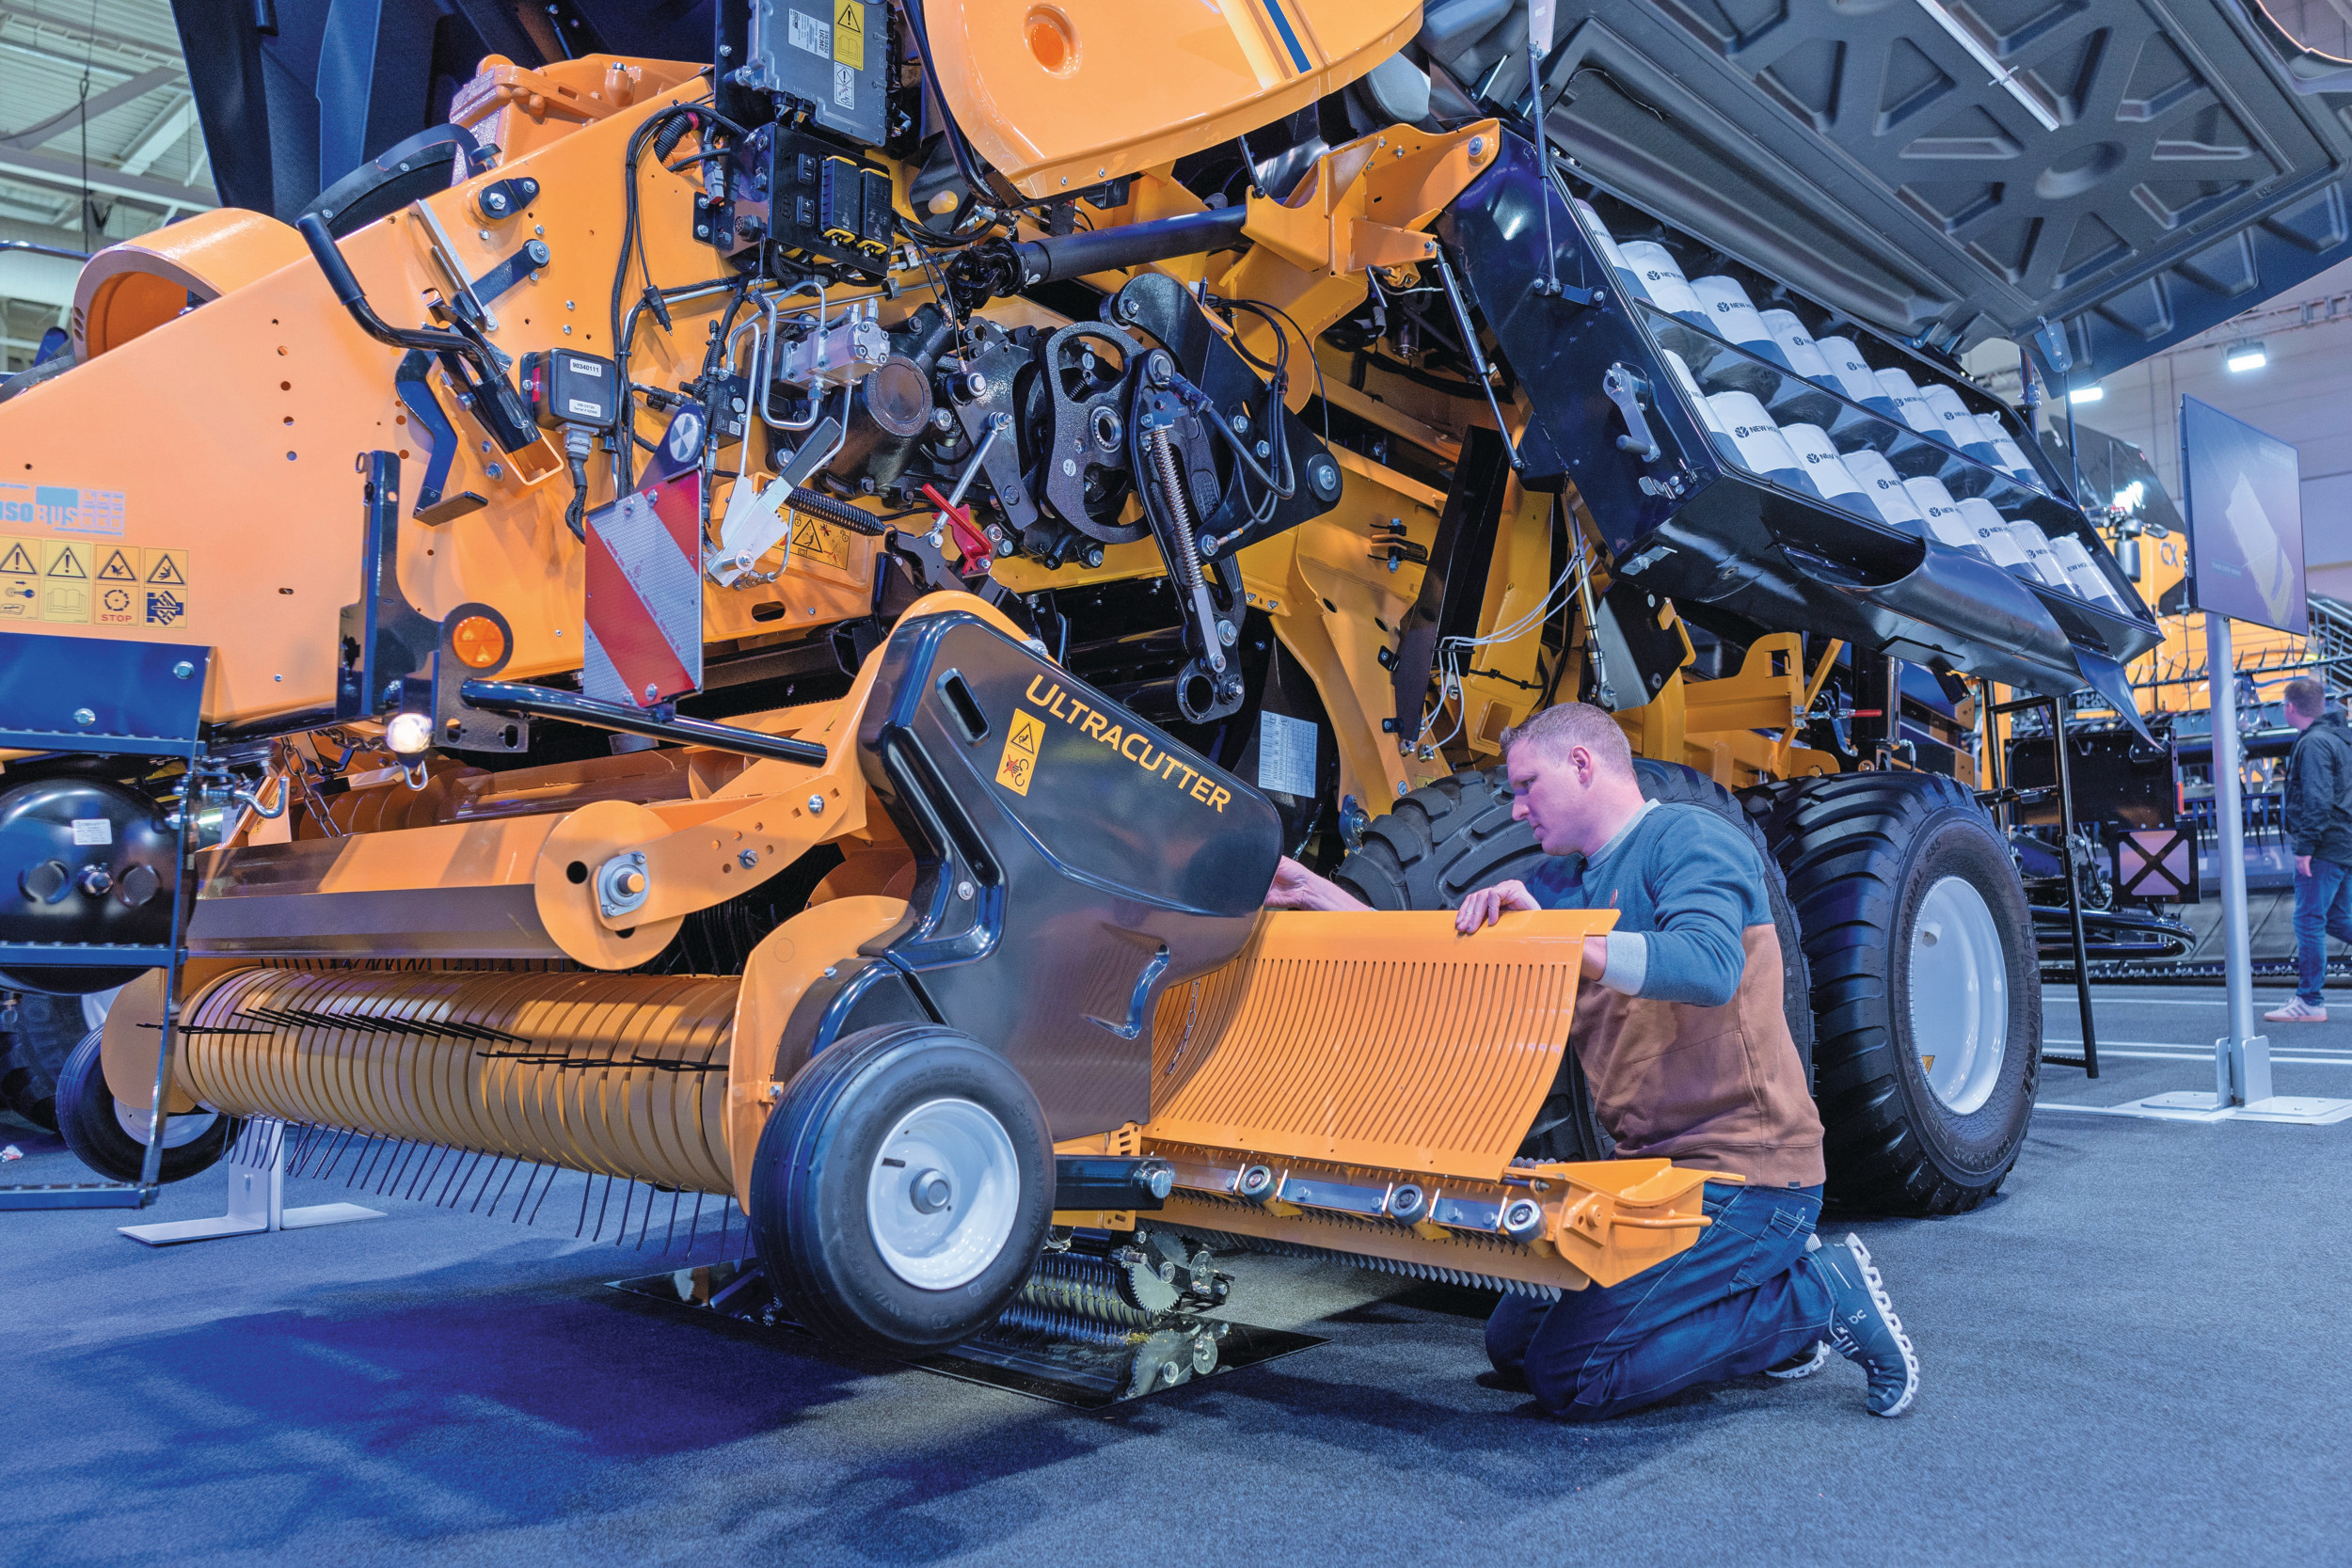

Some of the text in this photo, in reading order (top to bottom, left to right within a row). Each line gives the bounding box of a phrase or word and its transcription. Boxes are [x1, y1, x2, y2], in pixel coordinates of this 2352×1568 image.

[572, 362, 599, 372] 90340111
[2161, 541, 2179, 567] CX
[1025, 674, 1232, 813] ULTRACUTTER
[1902, 869, 1925, 942] RADIAL
[2021, 953, 2040, 1102] ALLIANCE
